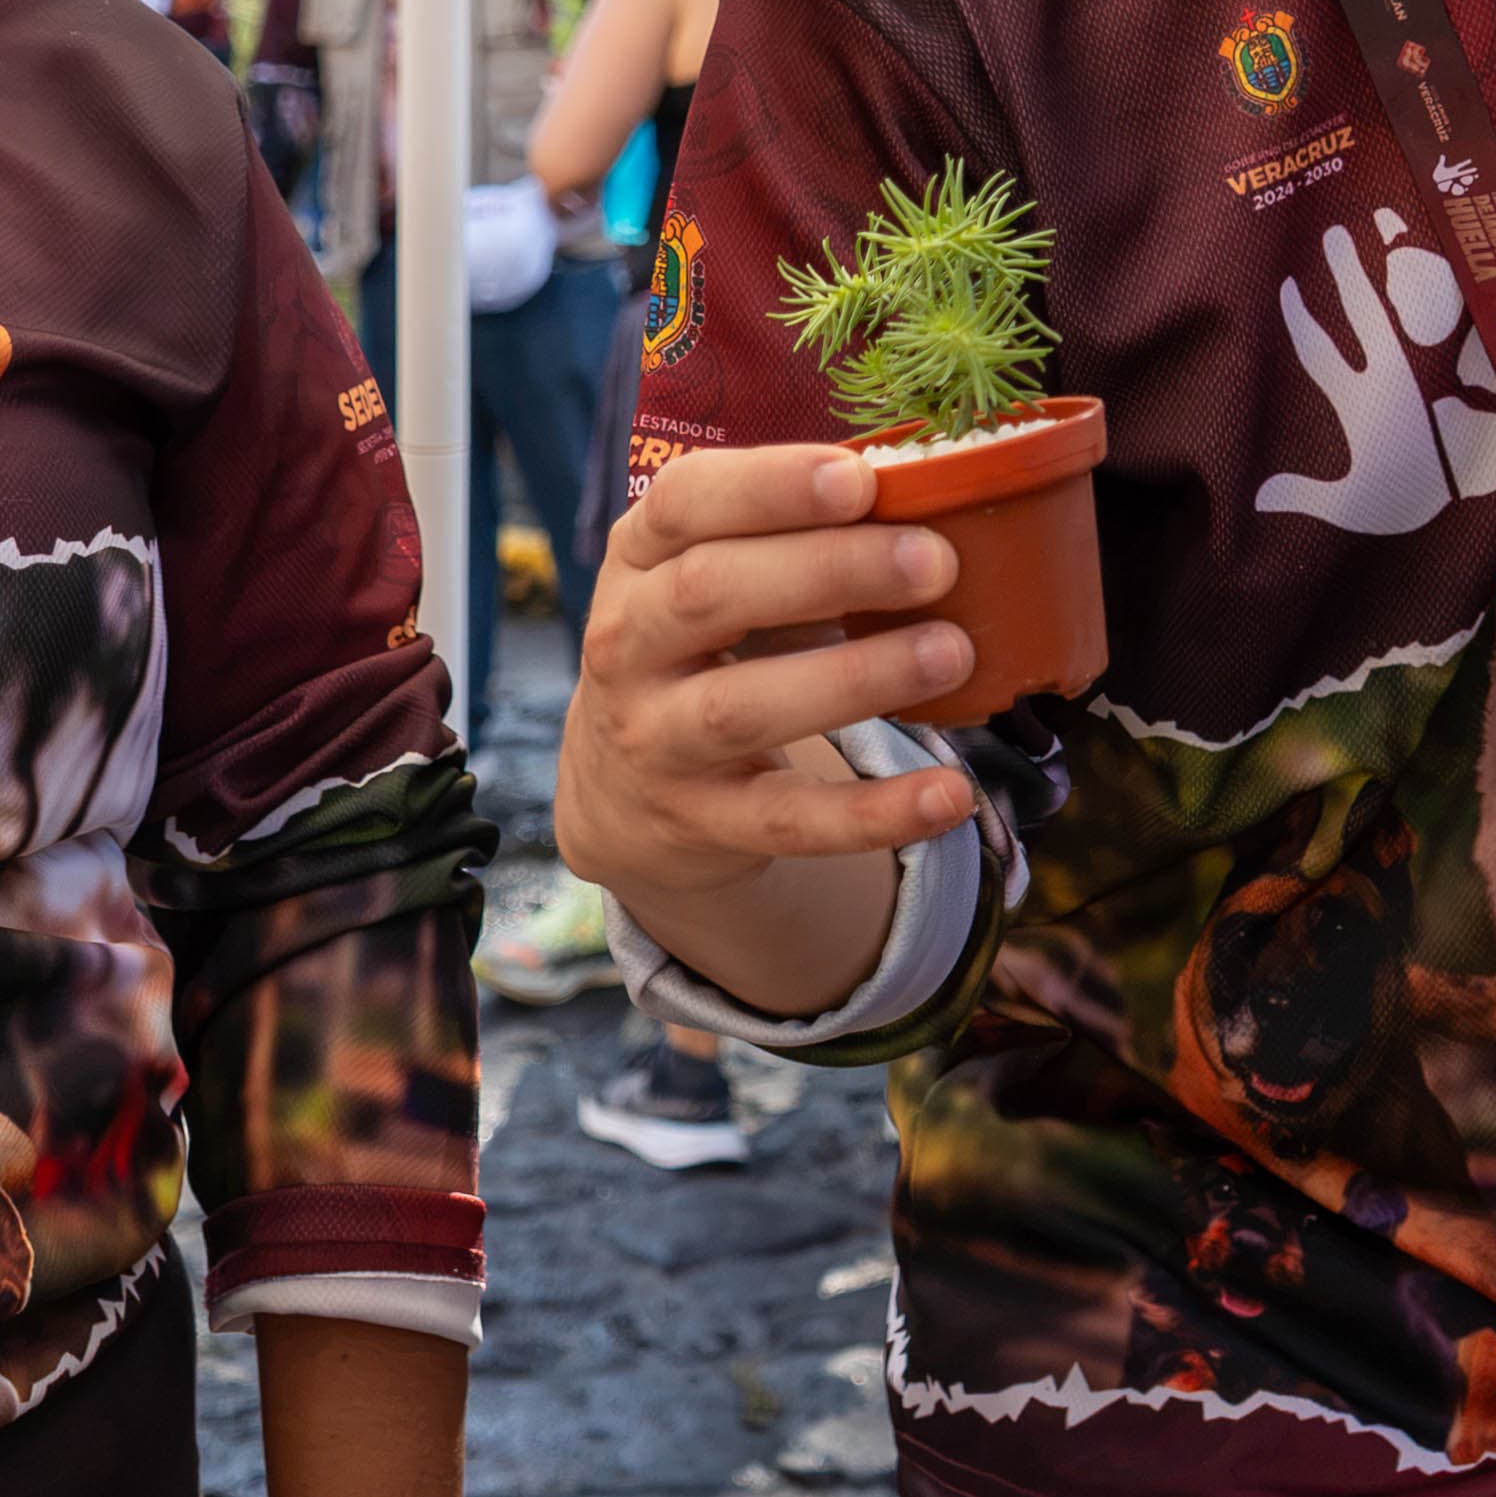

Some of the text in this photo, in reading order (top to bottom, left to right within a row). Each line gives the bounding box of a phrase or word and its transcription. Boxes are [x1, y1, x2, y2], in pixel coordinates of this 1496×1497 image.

[1418, 81, 1449, 144] VERACRUZ
[1226, 125, 1356, 196] VERACRUZ
[1252, 179, 1295, 211] 2024
[1303, 156, 1344, 187] 2030
[640, 413, 702, 438] ESTADO
[705, 425, 726, 442] DE
